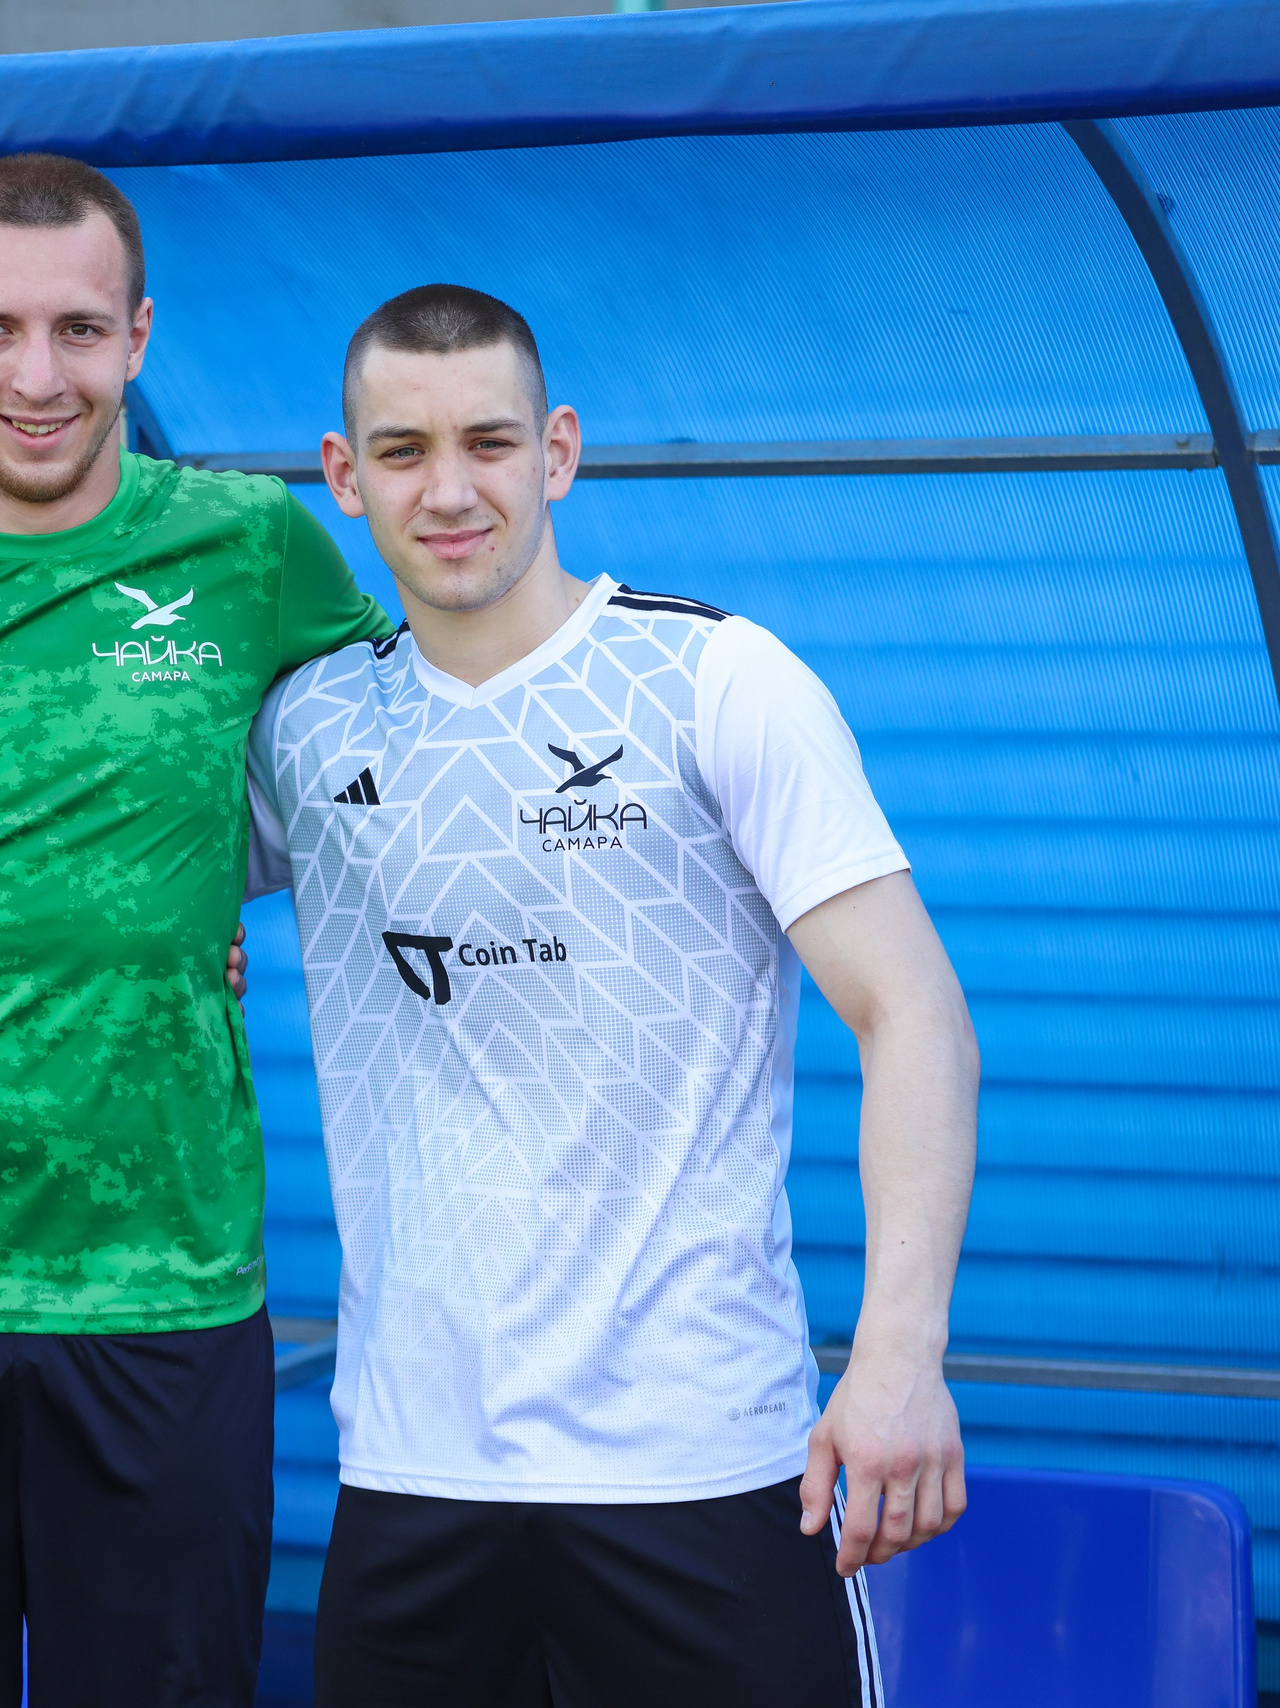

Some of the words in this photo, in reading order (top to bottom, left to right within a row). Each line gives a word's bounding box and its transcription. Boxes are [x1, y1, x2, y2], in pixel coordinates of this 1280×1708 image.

[92, 635, 223, 667] ЧАЙКА
[131, 671, 191, 682] САМАРА
[520, 799, 647, 834] ЧАЙКА
[542, 836, 622, 852] САМАРА
[458, 941, 517, 967] Coin
[523, 936, 567, 962] Tab
[743, 1402, 787, 1417] AEROREADY
